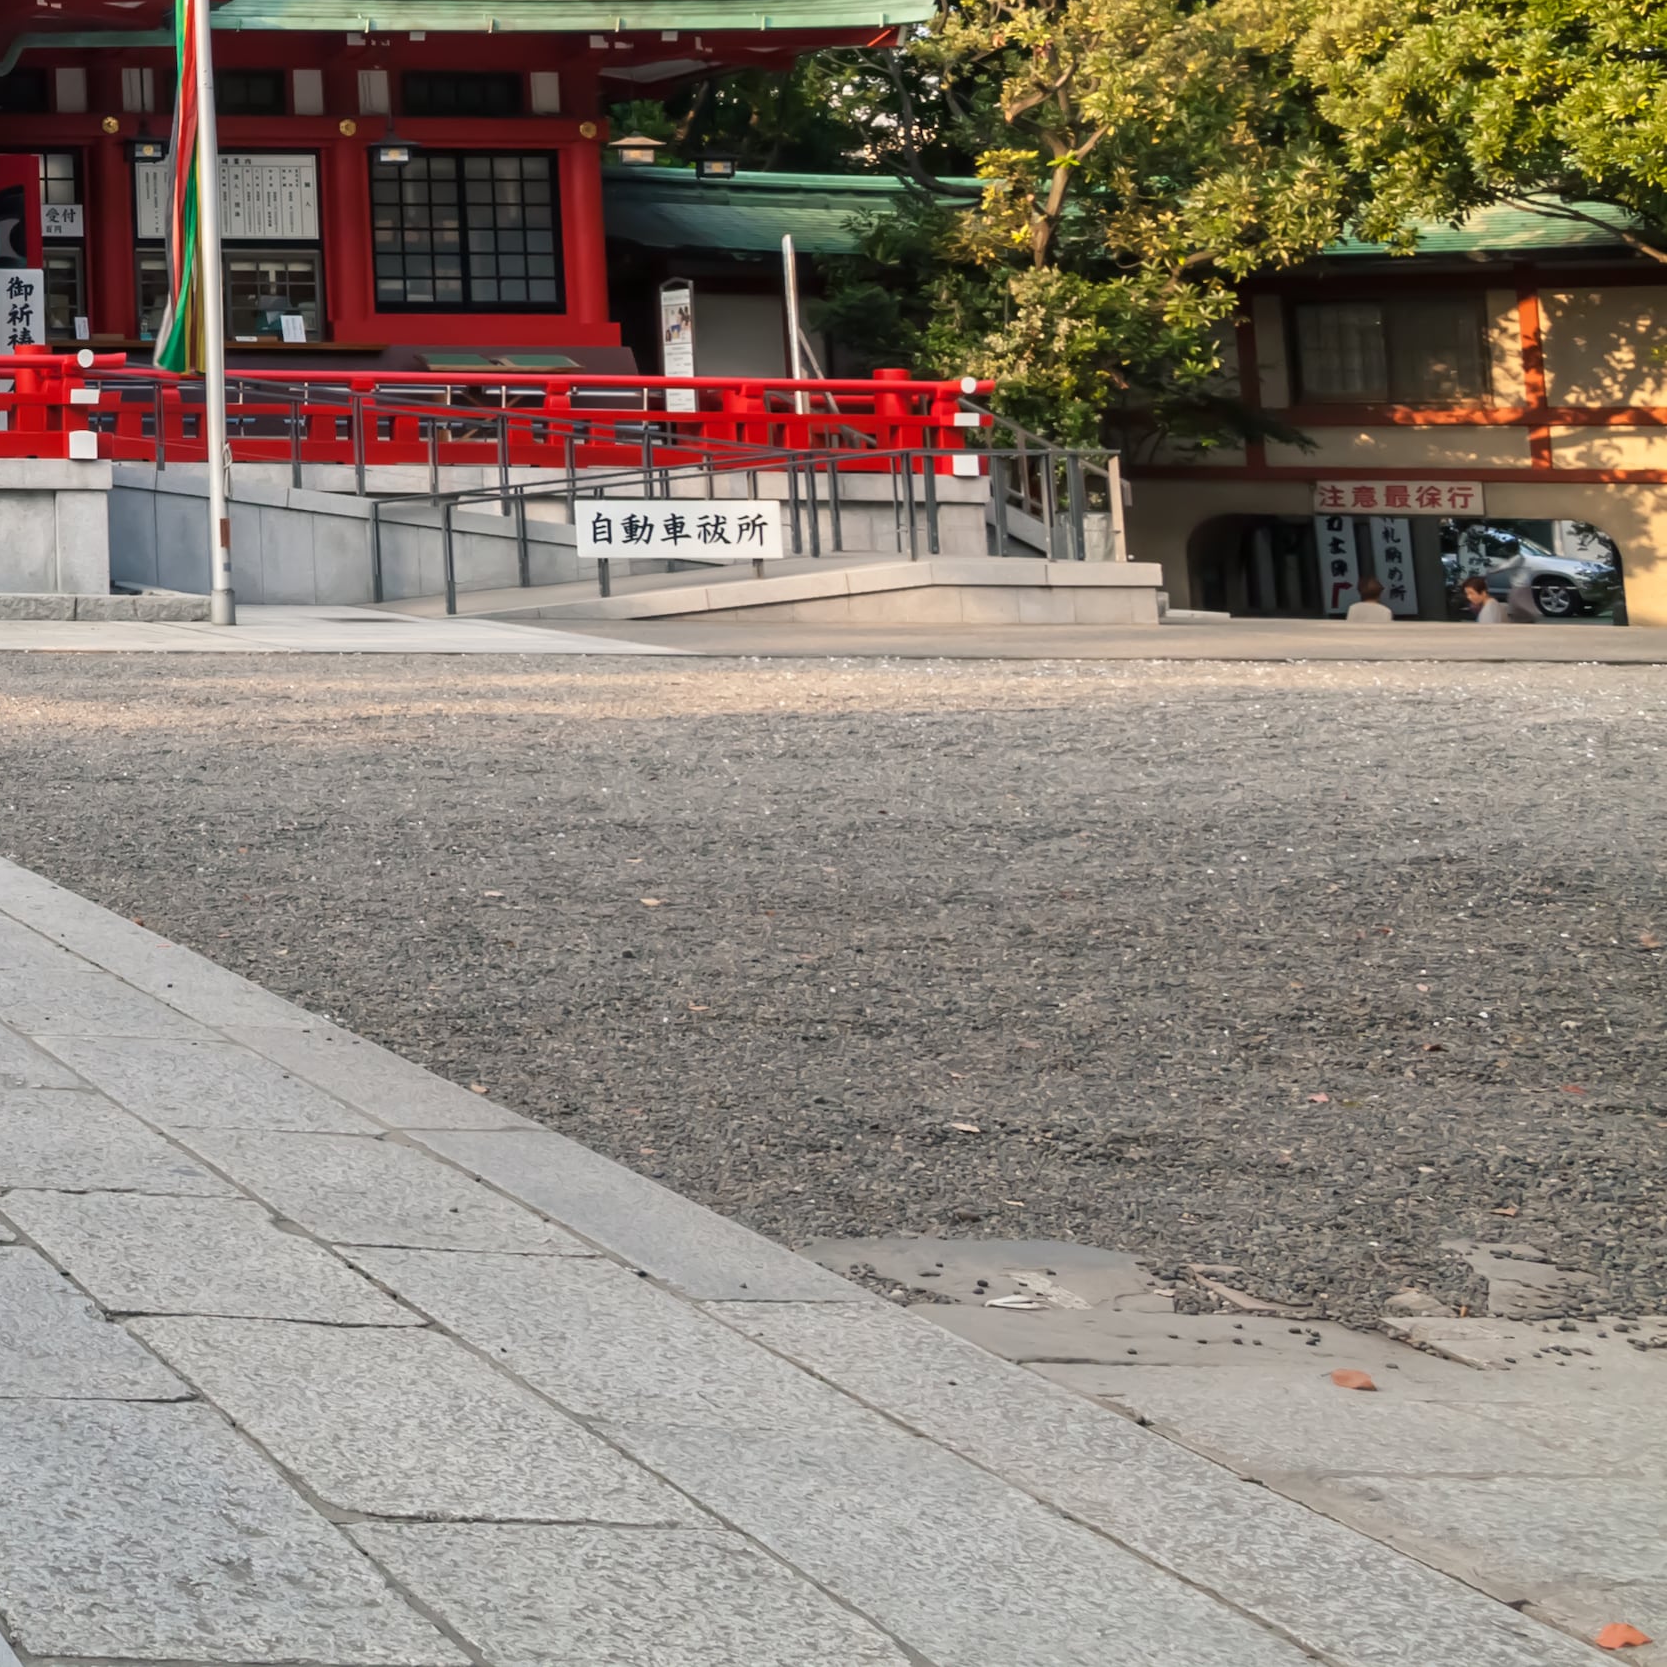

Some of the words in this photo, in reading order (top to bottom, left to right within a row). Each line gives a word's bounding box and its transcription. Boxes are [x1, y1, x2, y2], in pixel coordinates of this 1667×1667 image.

[45, 207, 77, 223] 受付
[1318, 484, 1474, 509] 注意最徐行
[591, 511, 769, 547] 自動車祓所
[1380, 518, 1408, 602] 札納め所
